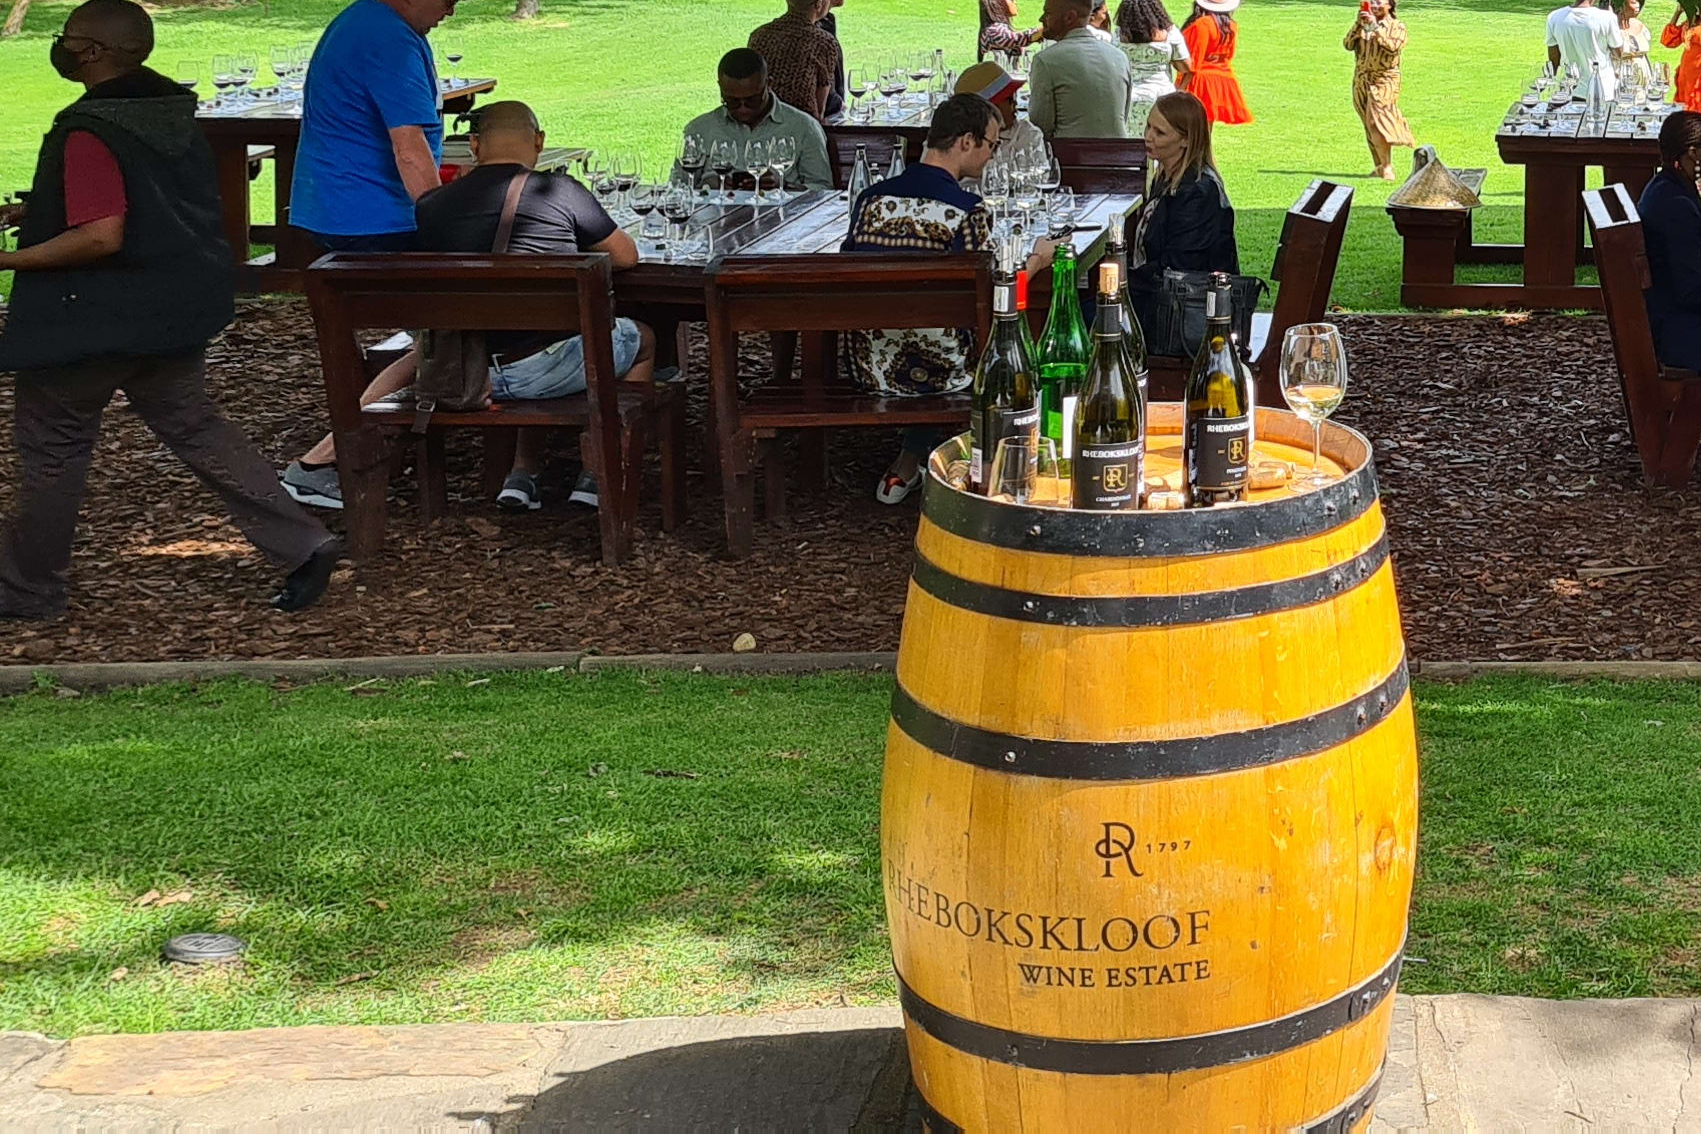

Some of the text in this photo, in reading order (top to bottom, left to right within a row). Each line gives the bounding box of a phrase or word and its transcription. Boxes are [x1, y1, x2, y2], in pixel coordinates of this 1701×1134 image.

[1146, 840, 1191, 854] 1797
[887, 859, 1211, 953] RHEBOKSKLOOF
[1018, 959, 1211, 988] WINE ESTATE
